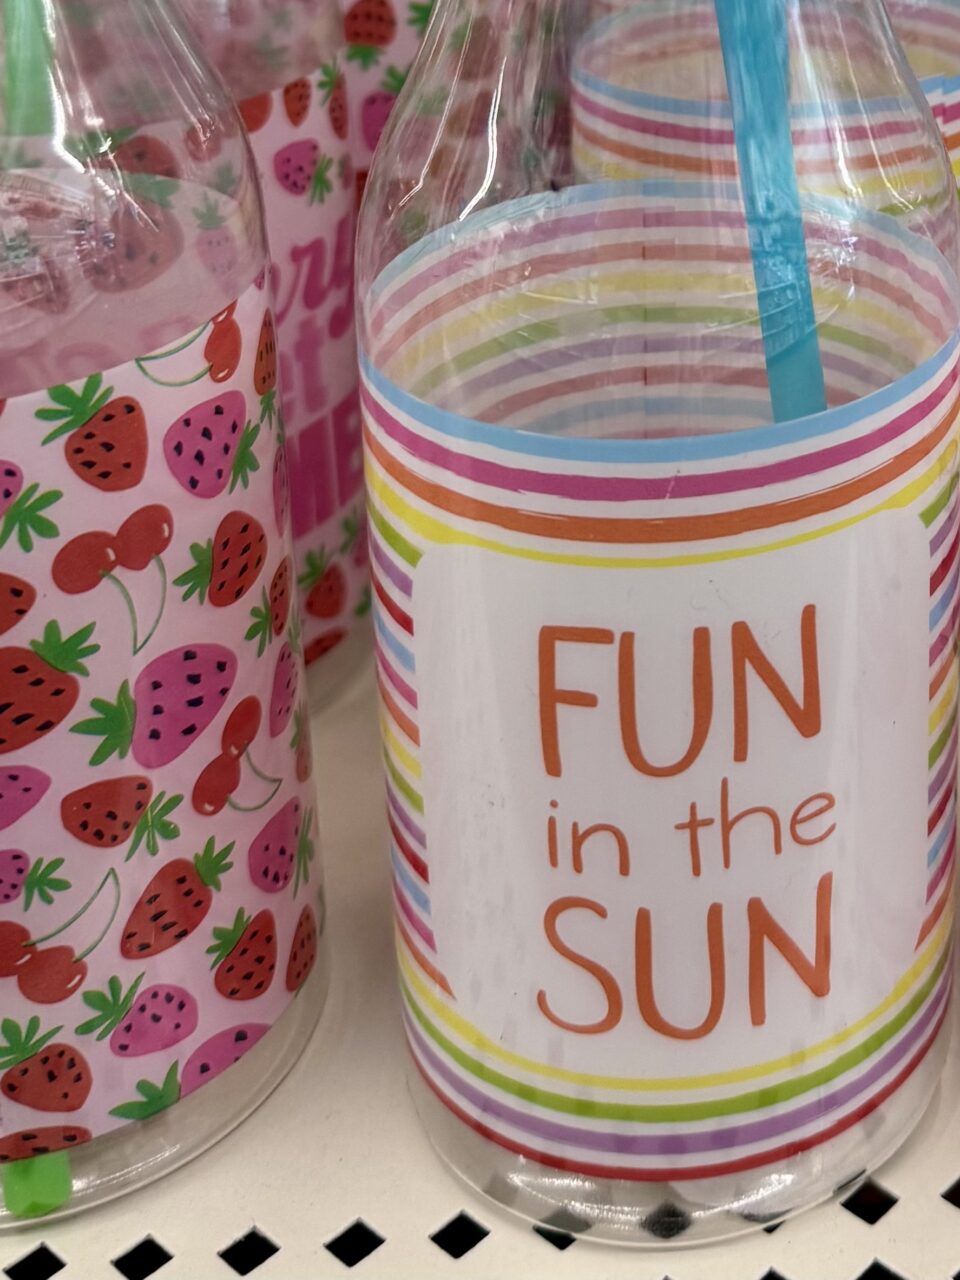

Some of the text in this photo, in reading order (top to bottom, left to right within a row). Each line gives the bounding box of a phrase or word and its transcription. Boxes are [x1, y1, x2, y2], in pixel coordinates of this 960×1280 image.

[537, 603, 822, 778] FUN
[547, 776, 837, 877] in the
[536, 871, 833, 1041] SUN
